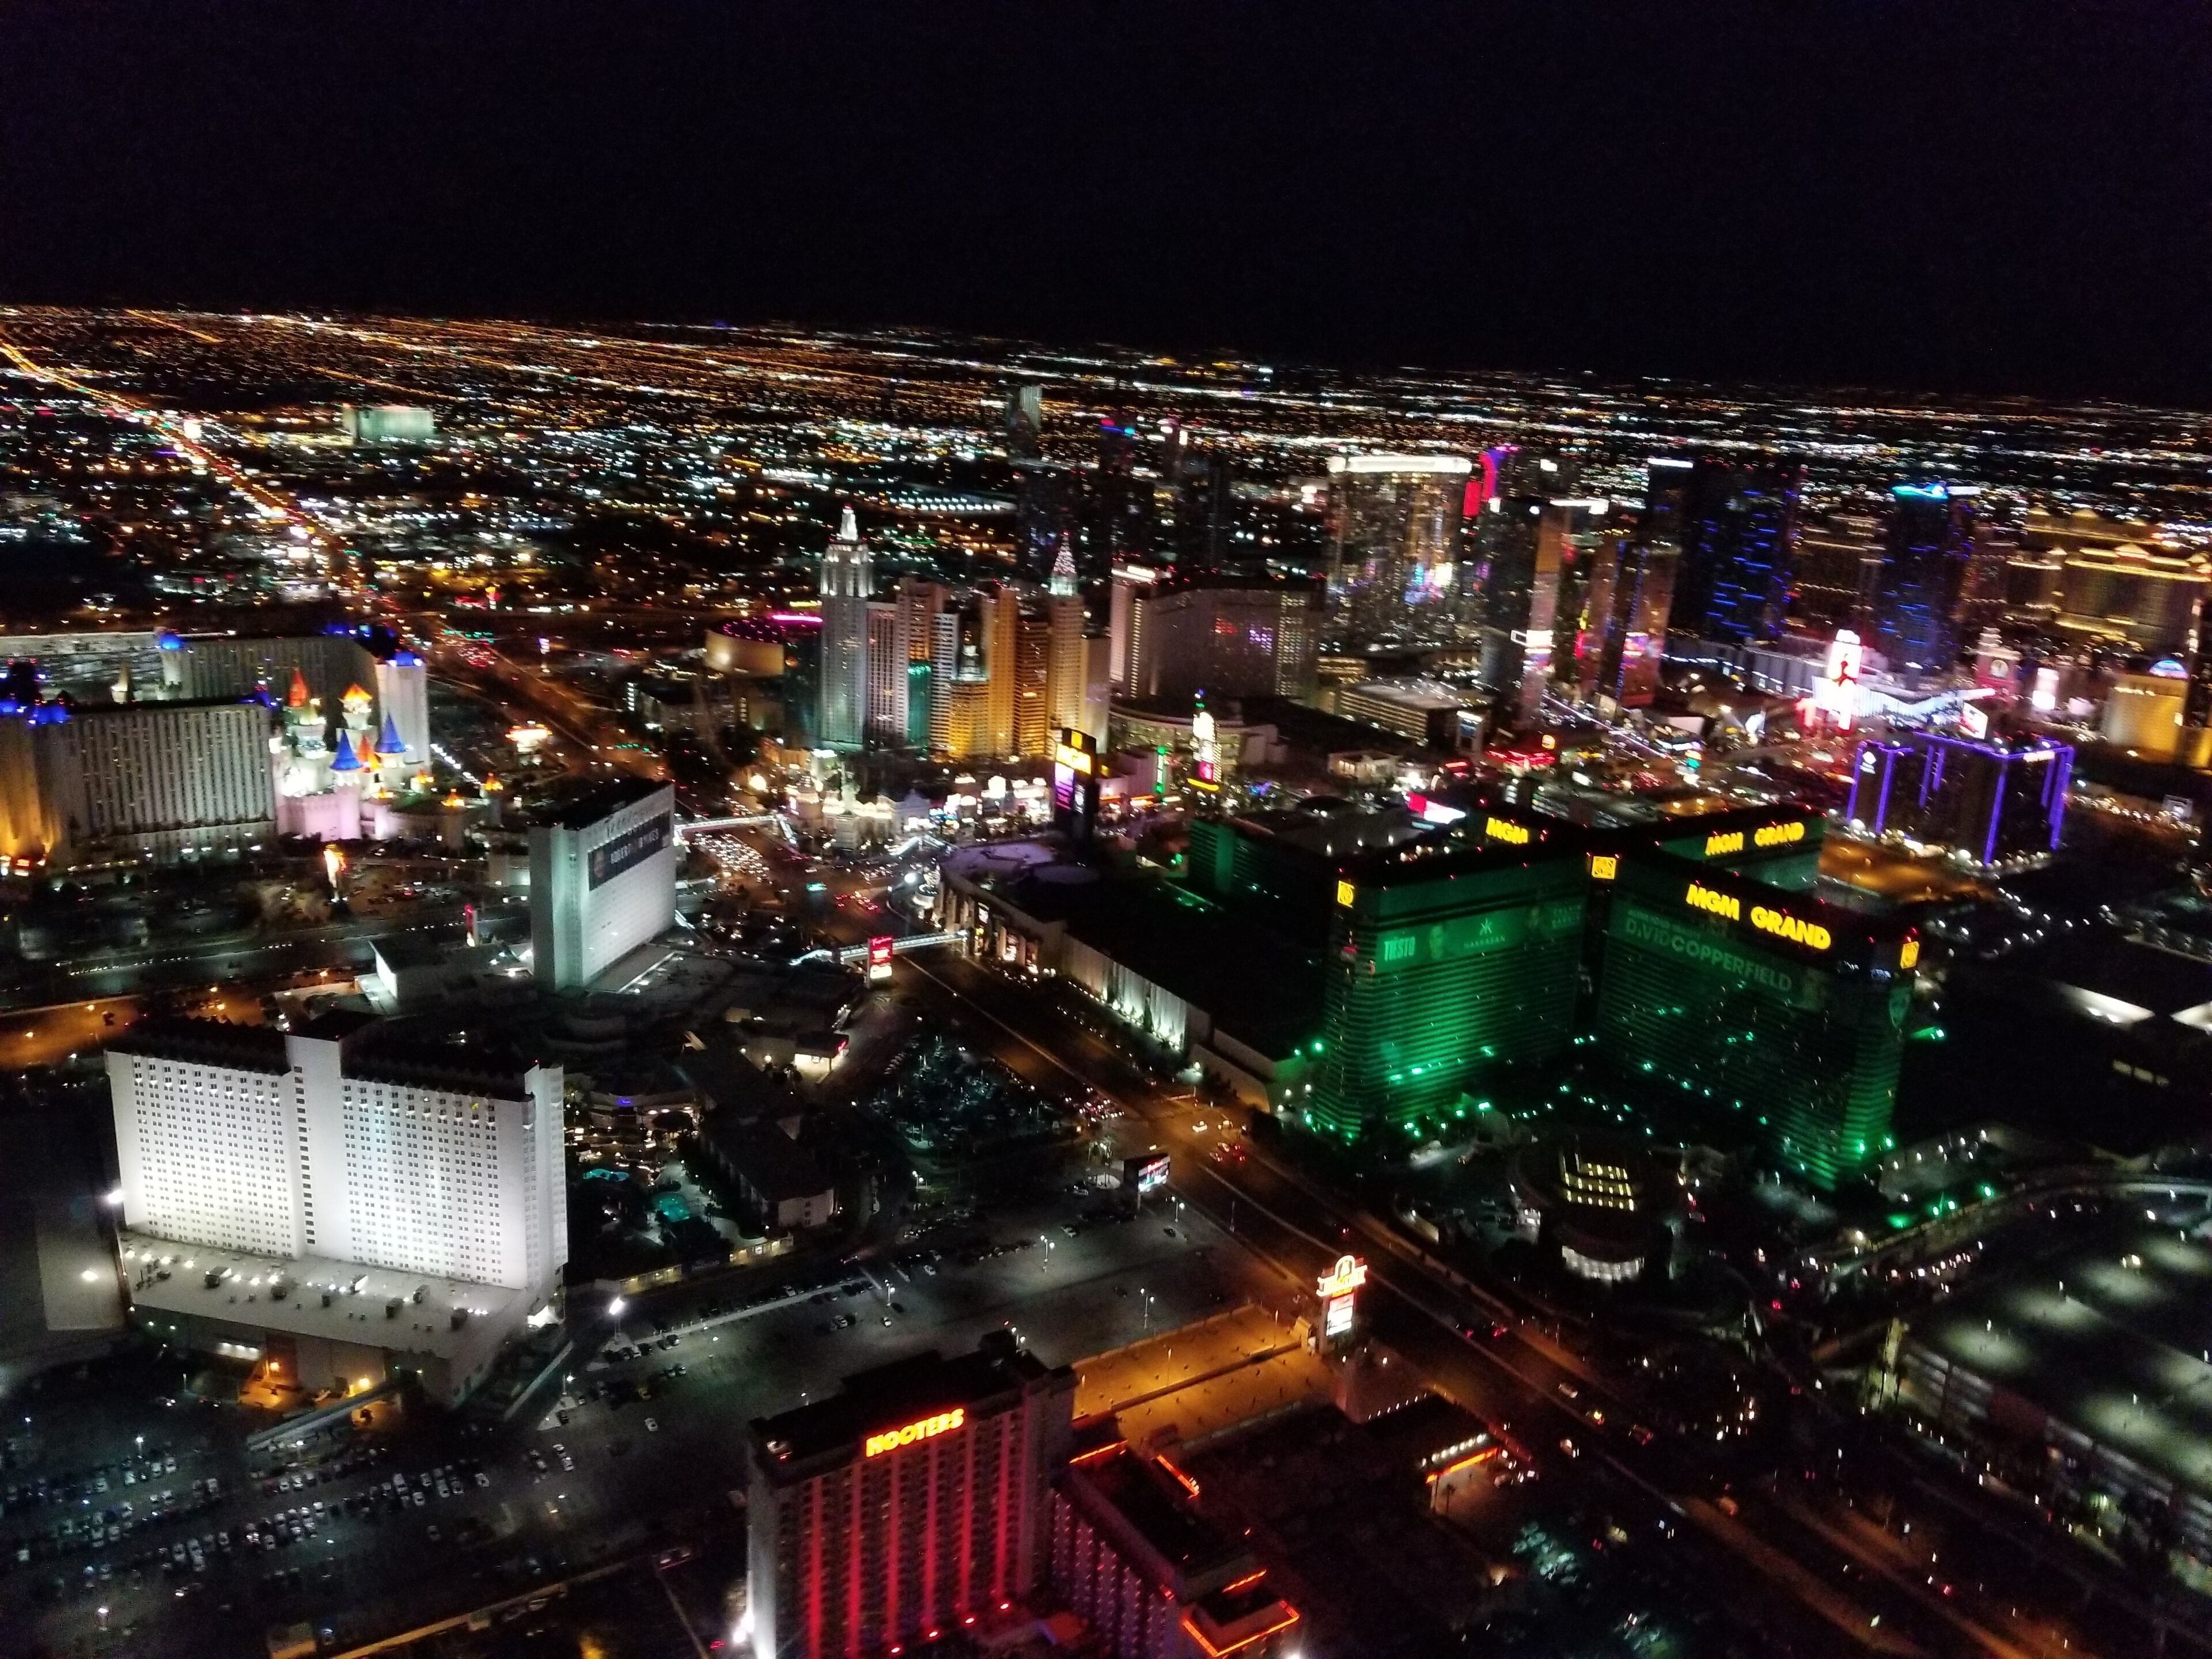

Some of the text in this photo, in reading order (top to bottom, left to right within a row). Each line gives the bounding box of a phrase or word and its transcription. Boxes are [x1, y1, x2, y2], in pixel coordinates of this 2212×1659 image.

[1486, 817, 1528, 845] MGM
[1705, 821, 1805, 856] MGM GRAND
[1685, 883, 1740, 921] MGM
[1749, 906, 1832, 950] GRAND
[1671, 934, 1793, 991] COPPERFIELD
[866, 1408, 964, 1457] HOOTERS
